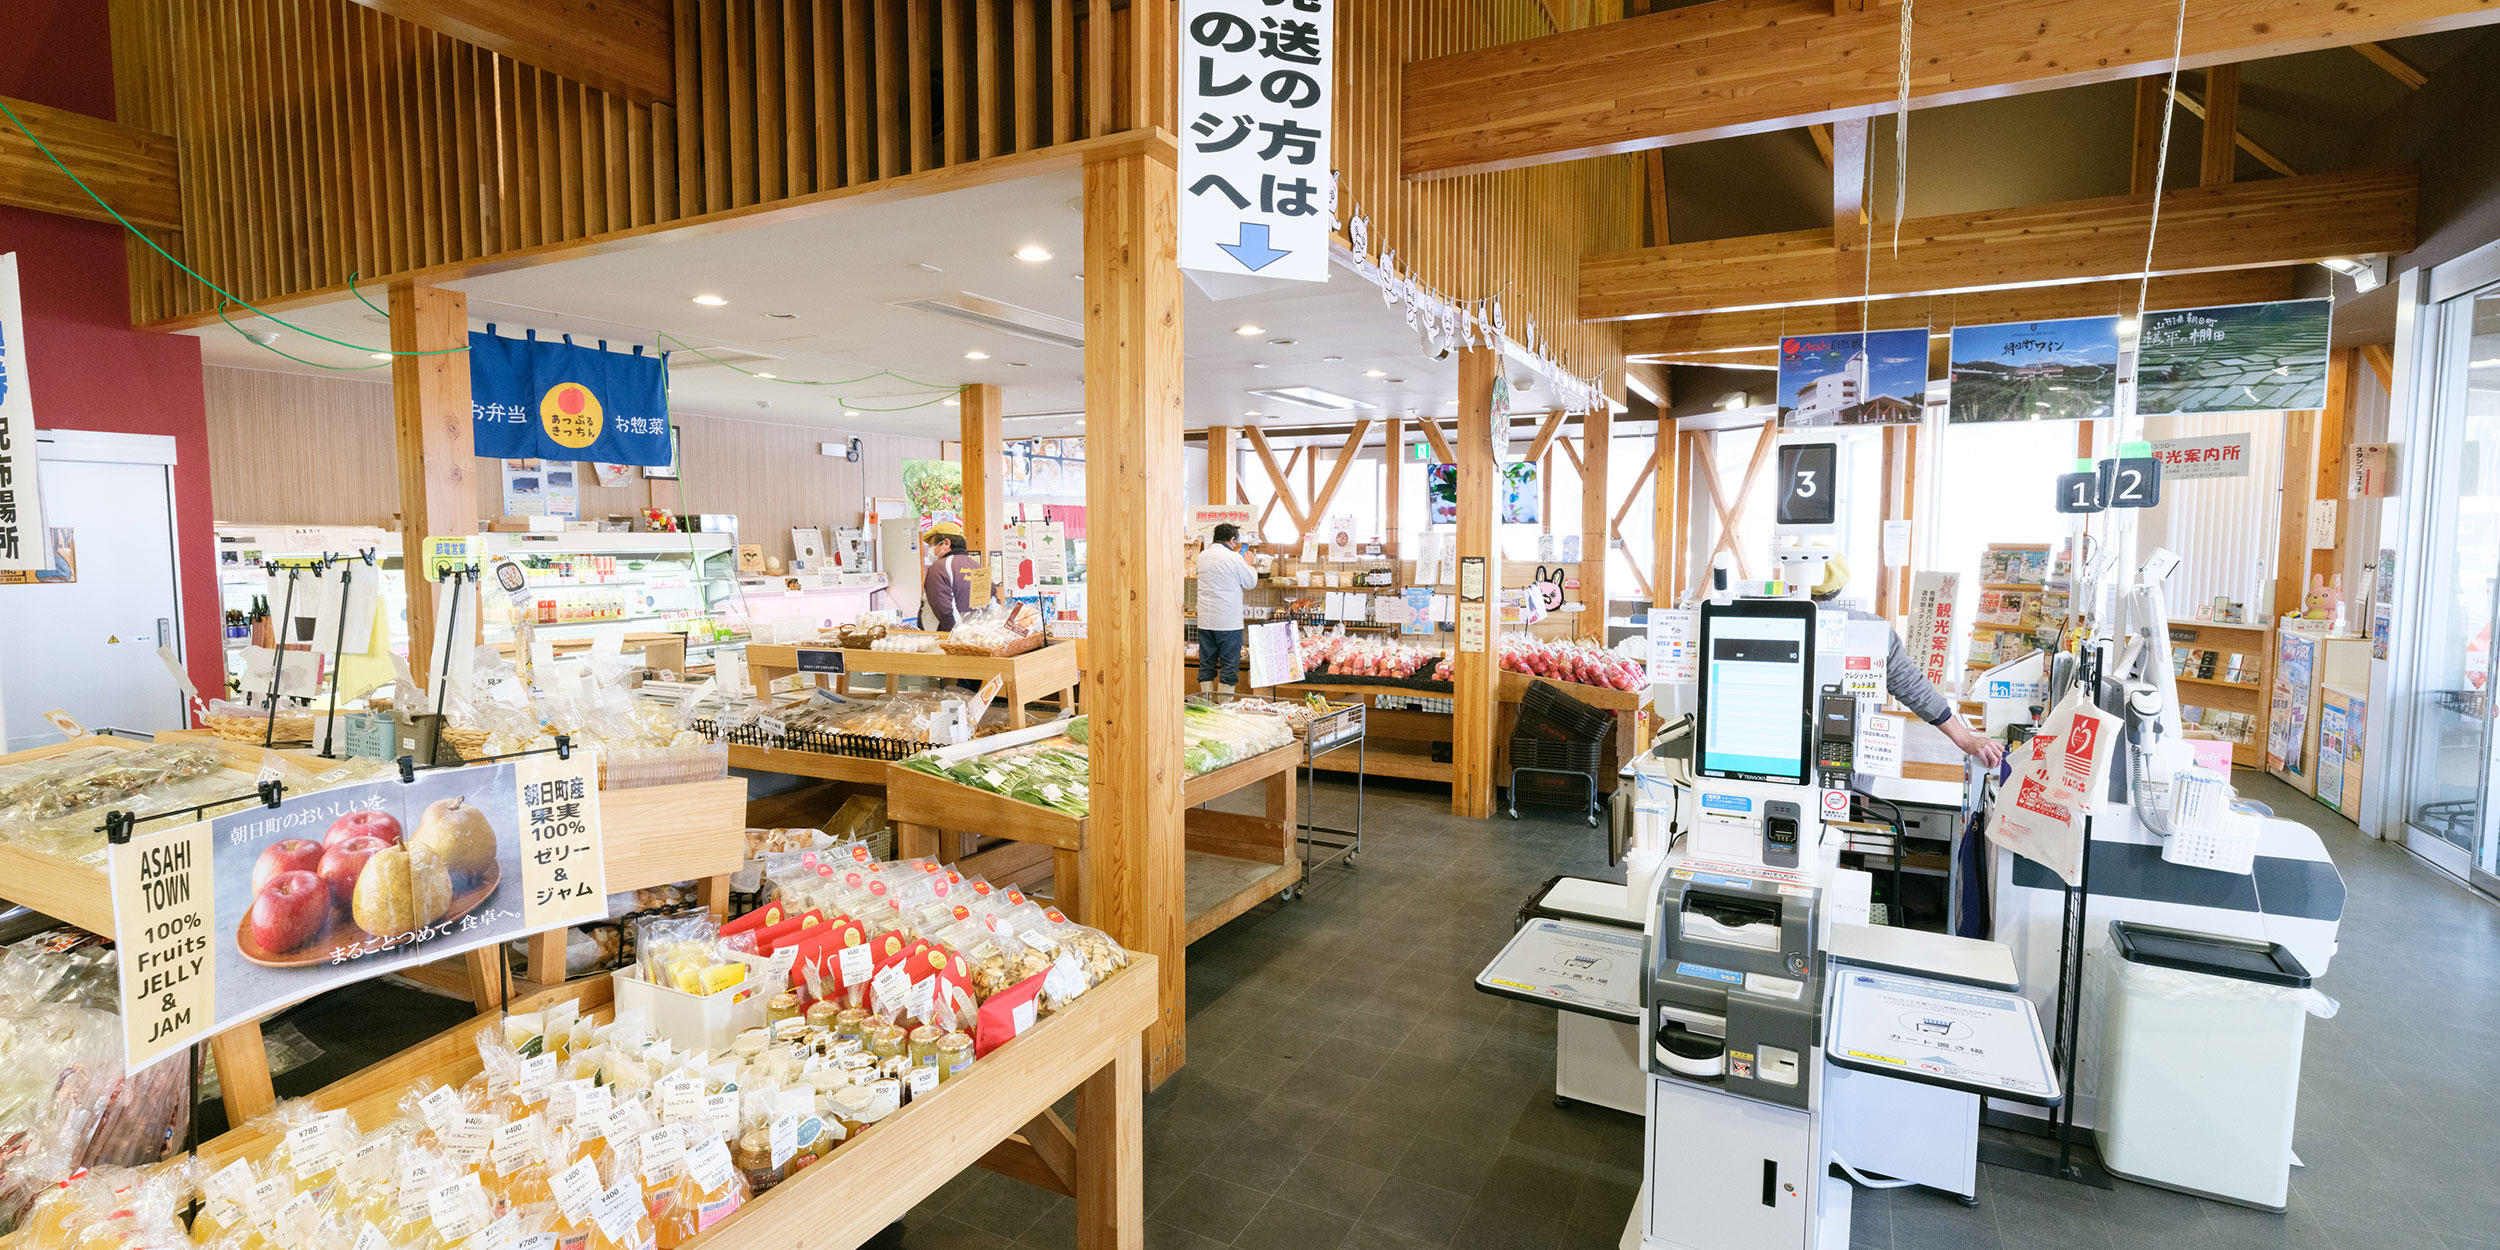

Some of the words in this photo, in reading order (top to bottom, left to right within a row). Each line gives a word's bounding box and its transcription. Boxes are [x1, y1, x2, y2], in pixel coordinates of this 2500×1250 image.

[1188, 11, 1257, 211] のレジへ
[1257, 0, 1322, 217] 送の方は
[2001, 339, 2065, 356] 朝日町ワイン
[472, 400, 528, 424] お弁当
[615, 415, 664, 436] お惣菜
[1796, 471, 1817, 498] 3
[2072, 482, 2090, 507] 1
[2119, 469, 2143, 500] 2
[1926, 602, 1952, 685] 観光案内所
[1844, 672, 1884, 680] クレジットカード
[523, 776, 585, 808] 朝日町産
[529, 801, 581, 828] 果実
[532, 820, 587, 842] 100%
[141, 840, 192, 881] ASAHI
[534, 840, 592, 867] ゼリー
[552, 866, 569, 882] &
[143, 872, 191, 914] TOWN
[535, 880, 594, 907] ジャム
[144, 913, 202, 945] 100%
[329, 919, 453, 966] まるごとつめて
[137, 935, 206, 973] Fruits
[137, 956, 204, 1000] JELLY
[1537, 966, 1609, 985] カート置き場
[161, 992, 178, 1012] &
[148, 1009, 192, 1044] JAM
[1889, 1033, 1985, 1056] カート置き場
[675, 1083, 691, 1091] ¥880
[708, 1097, 724, 1106] ¥880
[465, 1117, 483, 1125] ¥400
[608, 1108, 626, 1122] ¥650
[299, 1125, 319, 1138] ¥780
[450, 1131, 484, 1139] りんごゼリー
[505, 1123, 523, 1136] ¥400
[651, 1130, 668, 1142] ¥650
[357, 1146, 375, 1159] ¥780
[498, 1138, 529, 1152] りんごゼリー
[646, 1146, 676, 1161] りんごゼリー
[564, 1168, 580, 1184] ¥400
[439, 1184, 461, 1198] ¥780
[562, 1180, 590, 1203] りんごゼリー
[600, 1187, 619, 1204] ¥400
[598, 1198, 630, 1221] りんごゼリー
[518, 1235, 539, 1250] ¥780
